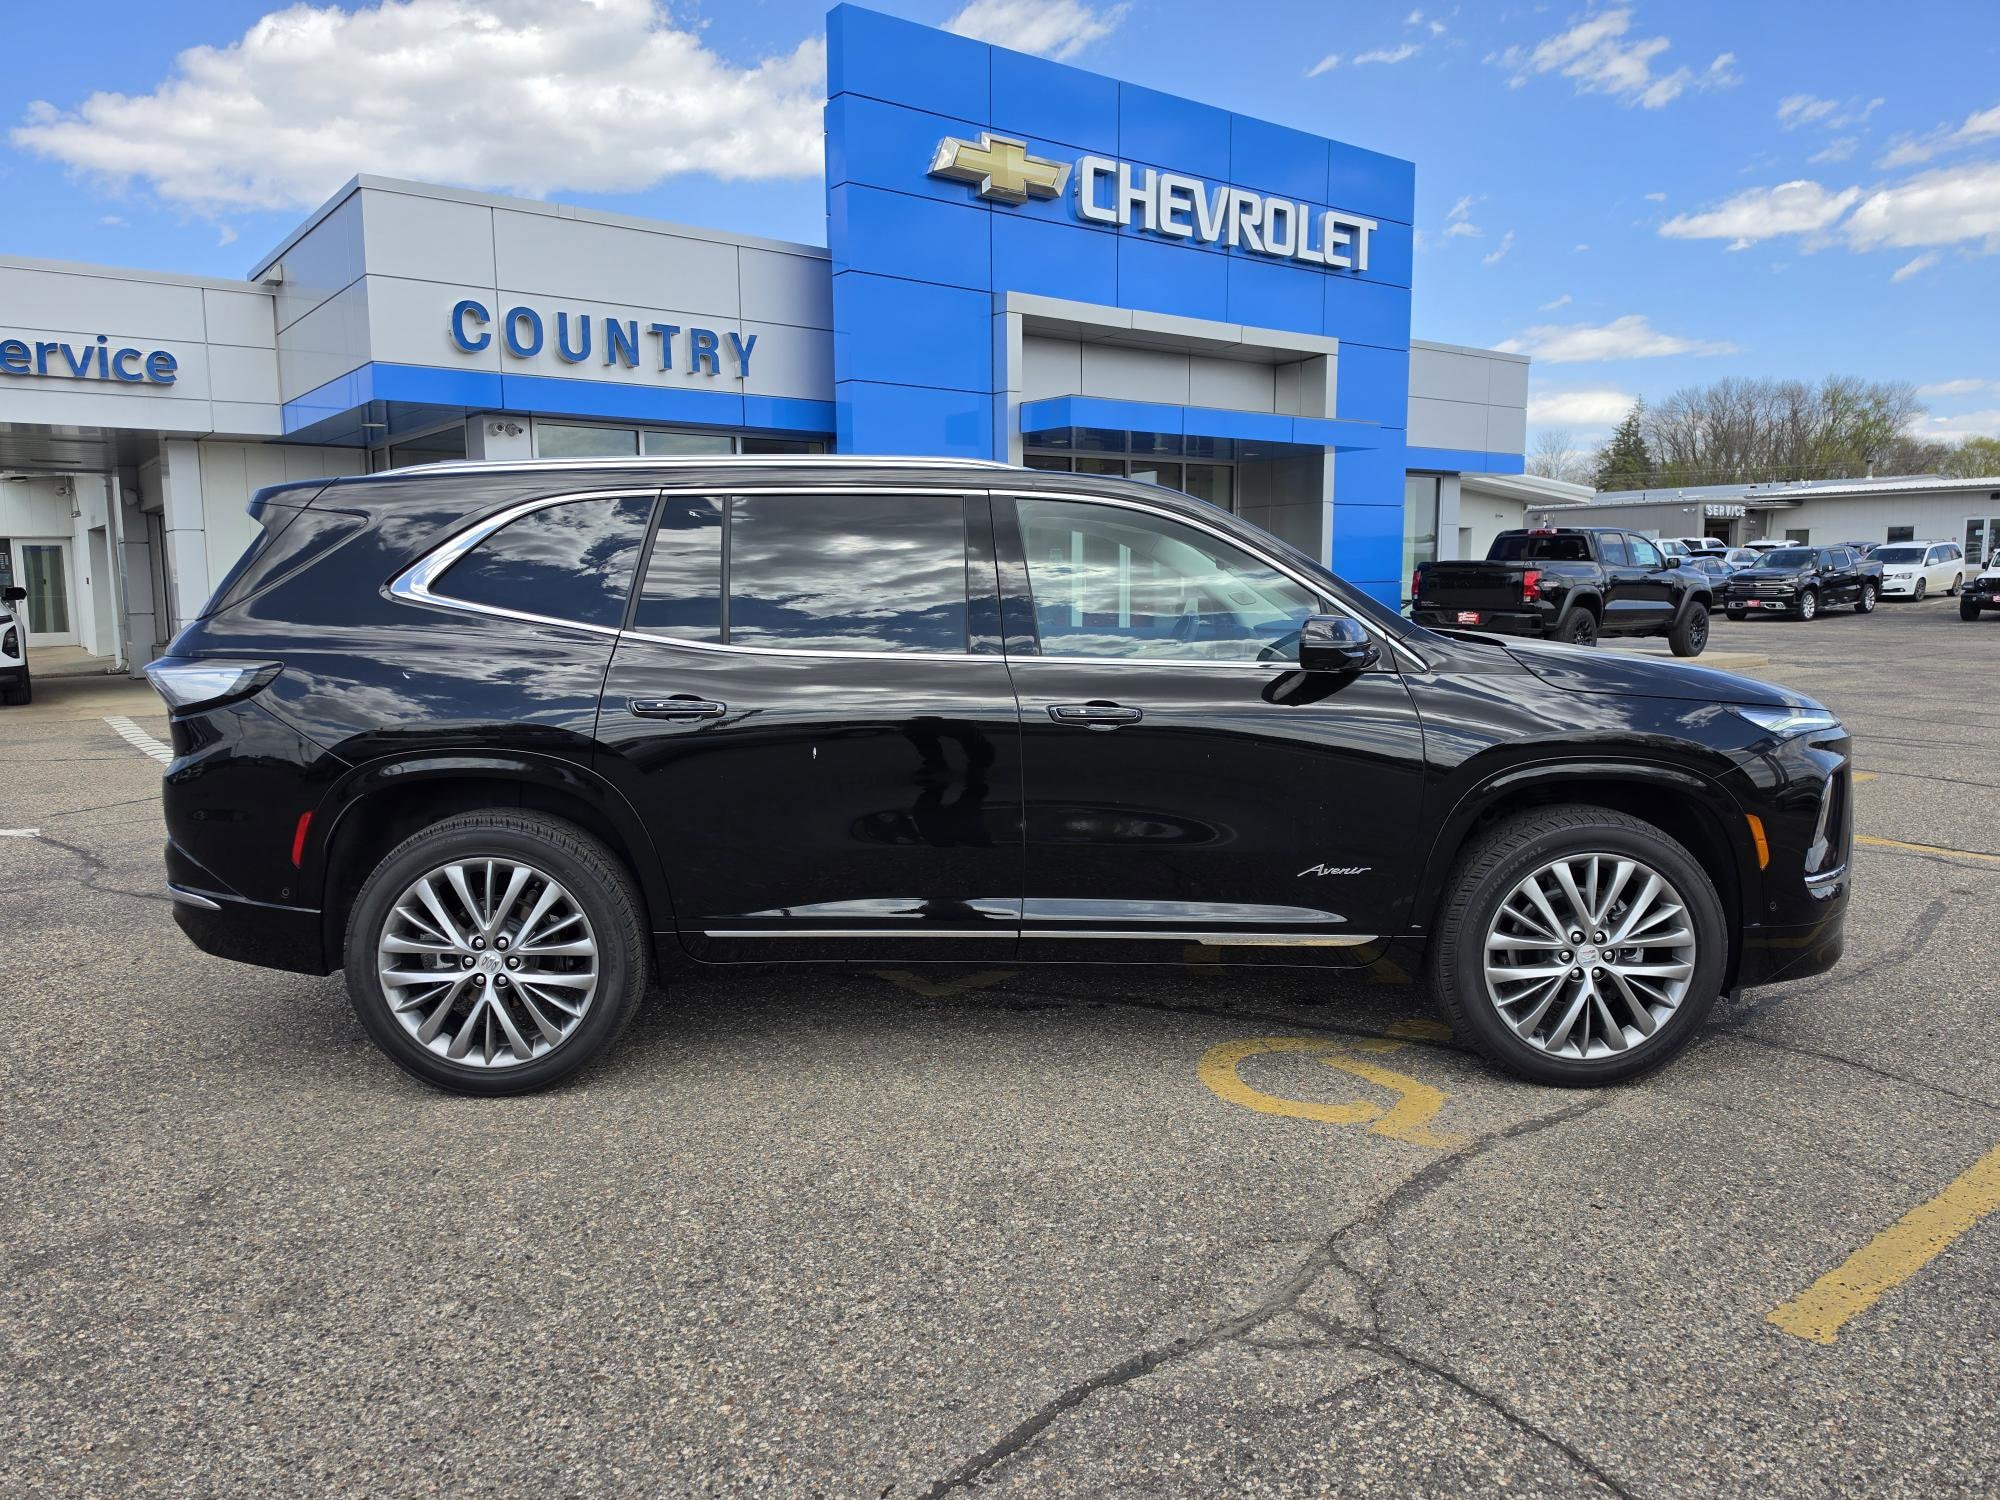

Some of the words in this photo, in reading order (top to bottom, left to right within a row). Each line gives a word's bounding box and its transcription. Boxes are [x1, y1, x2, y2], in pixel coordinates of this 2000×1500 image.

[1075, 155, 1378, 272] CHEVROLET
[449, 300, 758, 379] COUNTRY
[1705, 504, 1746, 517] SERVICE
[1297, 863, 1372, 877] Avenir
[1468, 845, 1548, 935] CONTINENTAL
